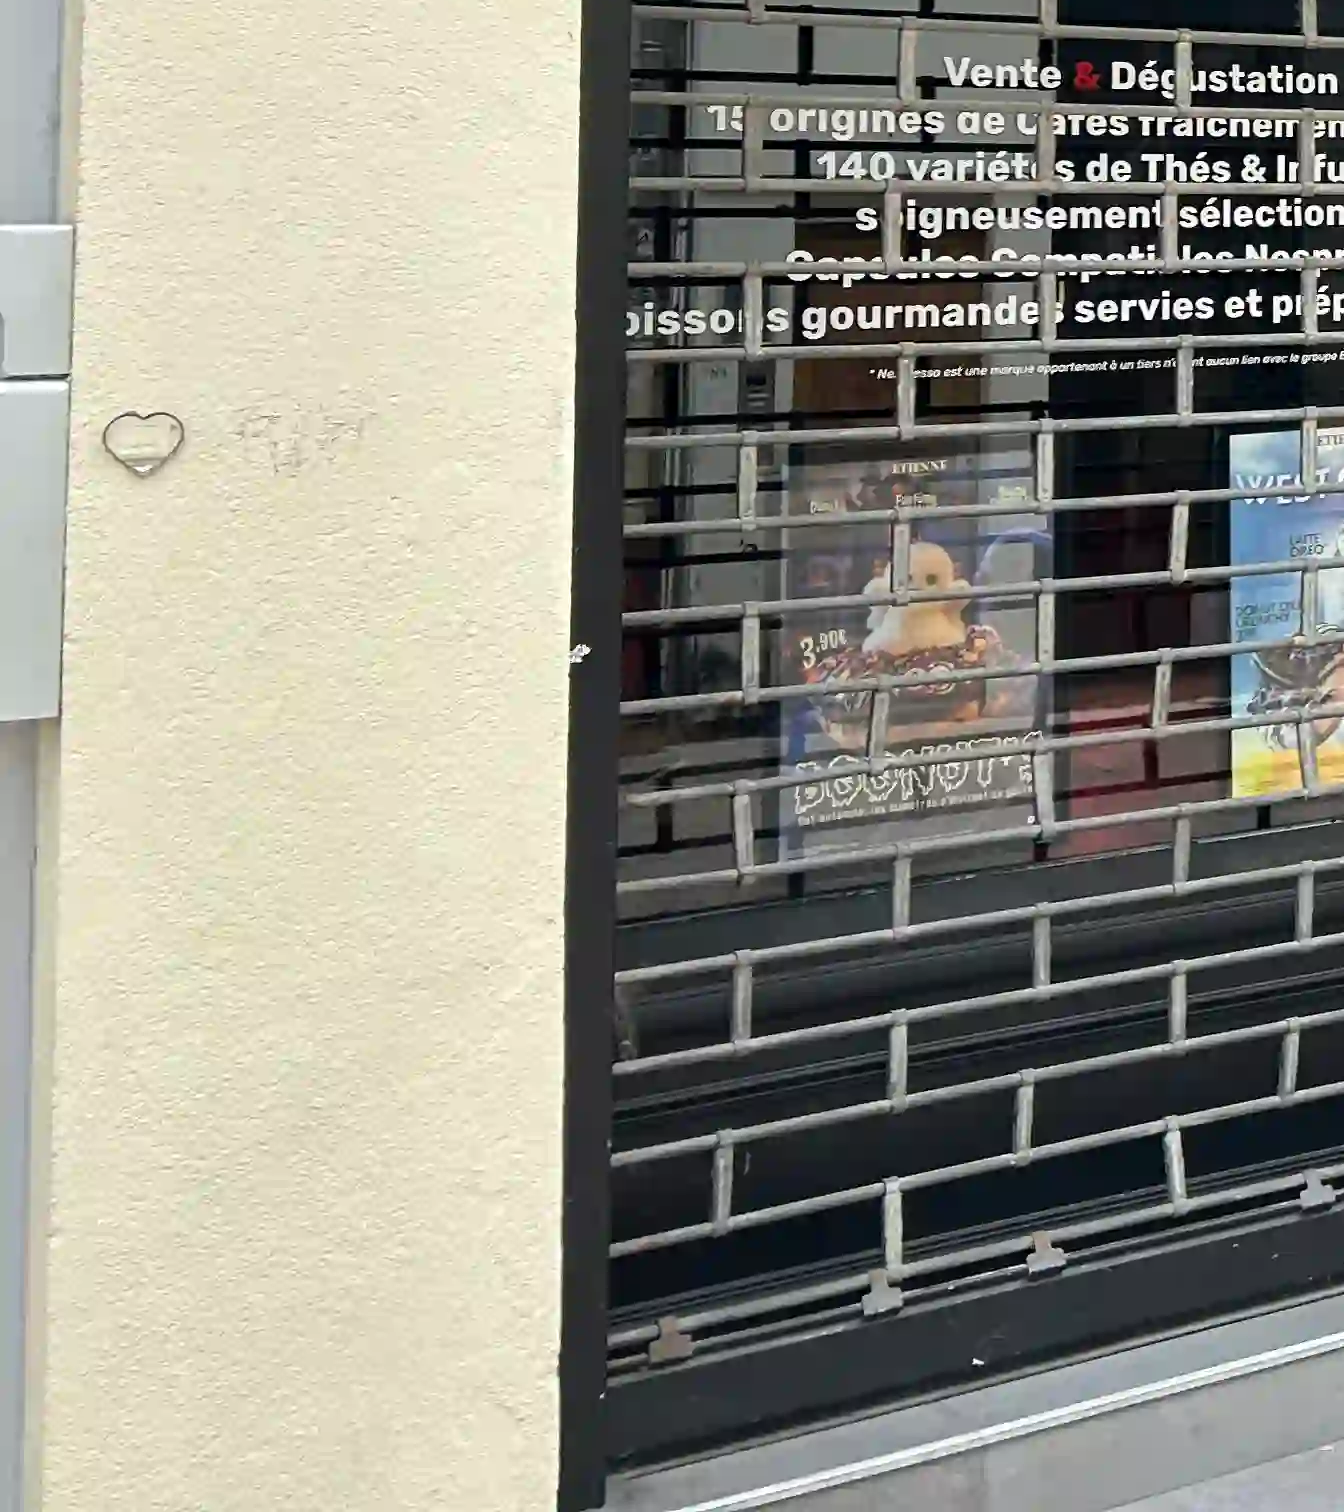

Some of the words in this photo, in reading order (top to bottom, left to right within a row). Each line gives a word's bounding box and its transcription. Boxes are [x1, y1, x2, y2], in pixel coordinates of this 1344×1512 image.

[944, 57, 1062, 88] Vente
[1074, 61, 1100, 90] &
[1111, 60, 1339, 99] Dégustation
[769, 107, 945, 141] origines
[816, 151, 895, 181] 140
[1085, 153, 1133, 182] de
[1141, 152, 1231, 183] Thés
[1240, 153, 1267, 183] &
[855, 199, 1164, 238] signeusement
[1074, 290, 1215, 324] servies
[1224, 288, 1263, 319] et
